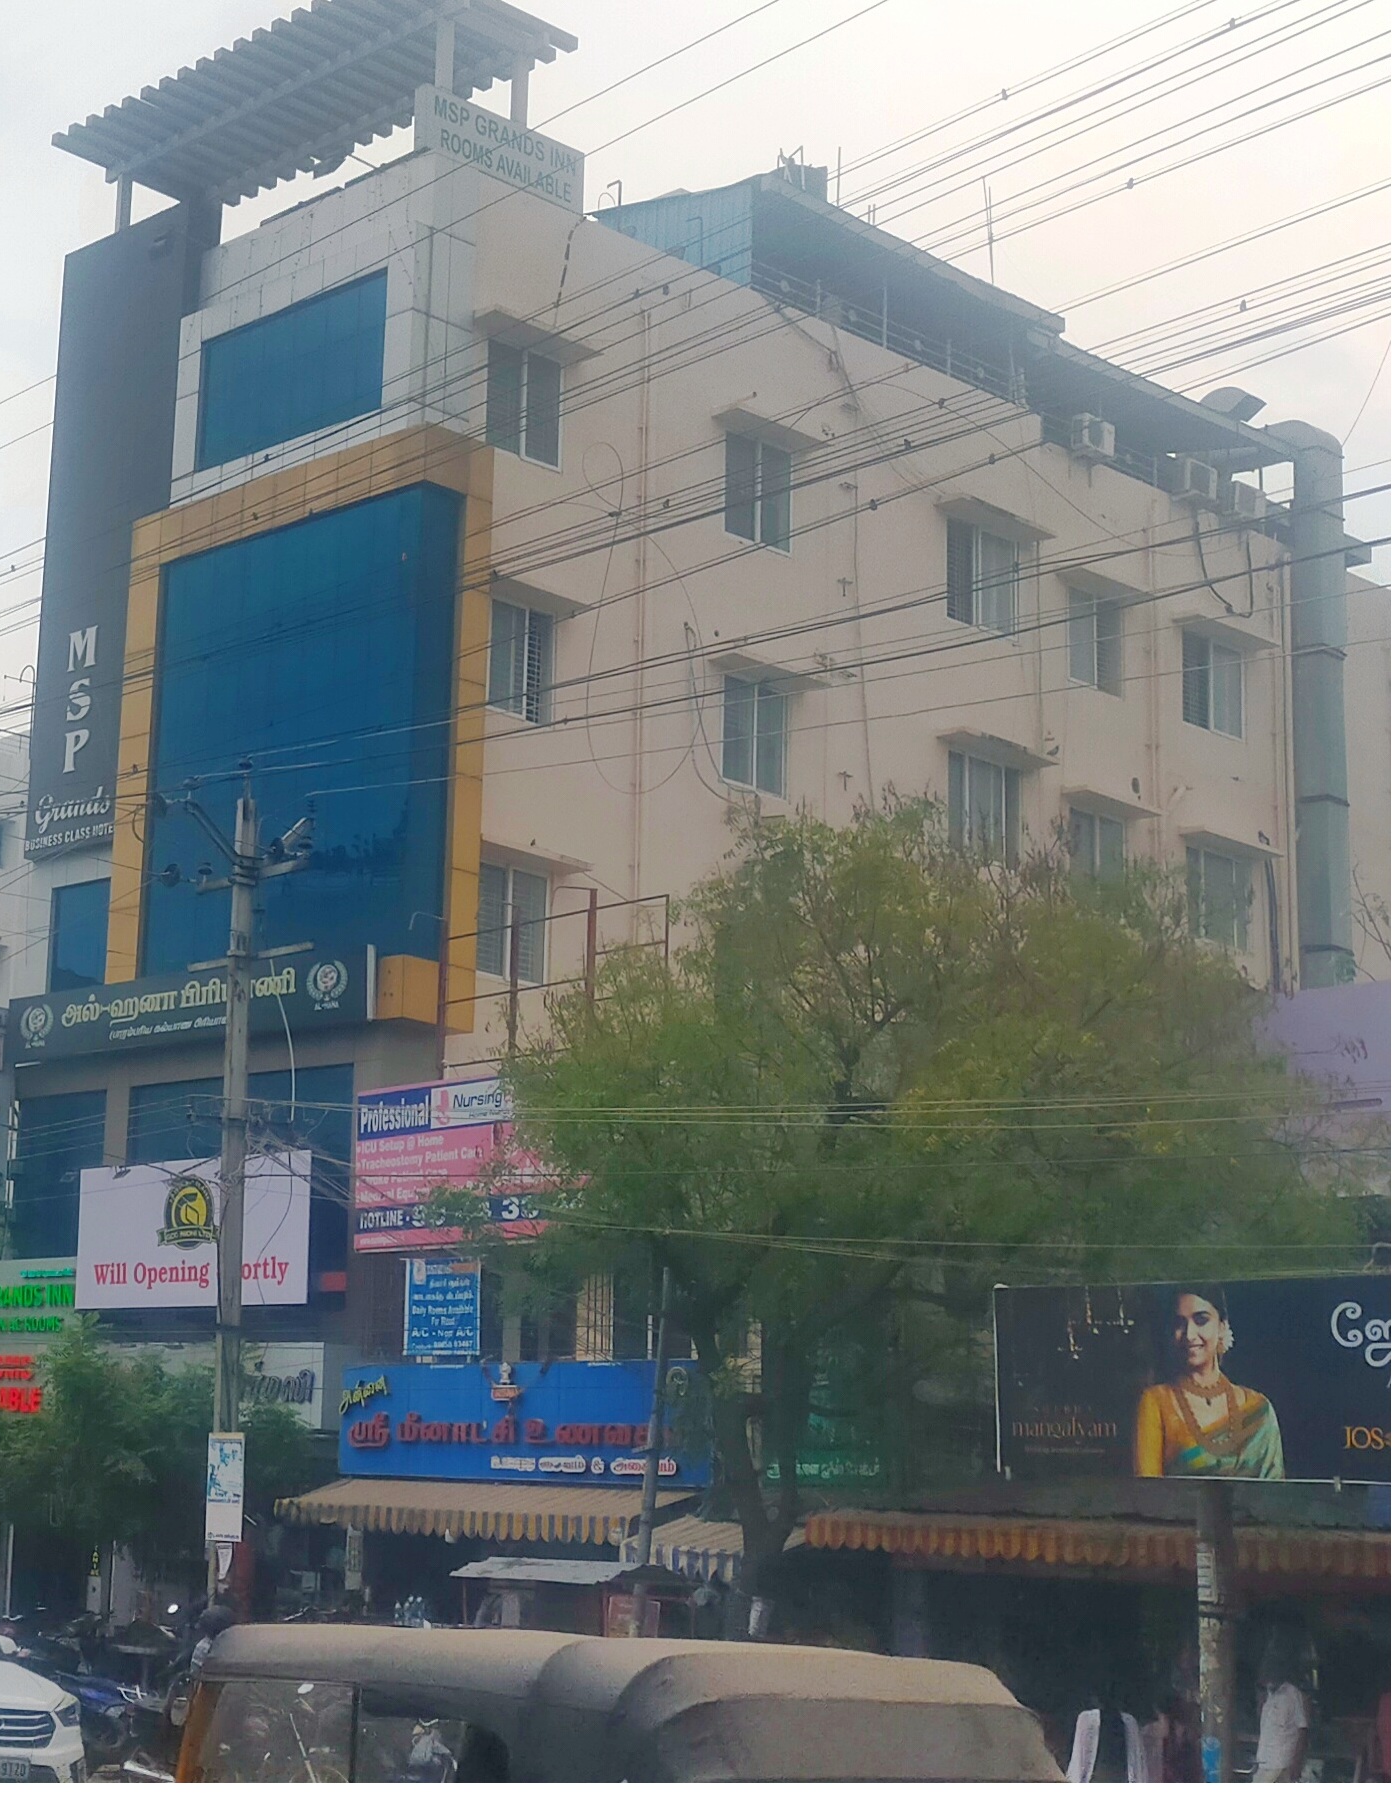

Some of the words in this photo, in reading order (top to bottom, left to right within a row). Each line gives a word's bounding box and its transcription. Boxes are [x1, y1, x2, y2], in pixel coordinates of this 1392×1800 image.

[434, 94, 470, 126] MSP
[475, 115, 545, 161] GRANDS
[550, 149, 576, 176] INN
[440, 128, 493, 169] ROOMS
[496, 154, 572, 203] AVAILABLE
[62, 624, 99, 775] MSP
[34, 785, 111, 834] Grands
[24, 832, 63, 852] BUSINESS
[64, 826, 91, 844] CLASS
[92, 822, 116, 837] HOTE
[360, 1094, 430, 1134] Professional
[453, 1090, 503, 1109] Nursing
[361, 1141, 377, 1154] ICU
[379, 1140, 405, 1153] Setup
[417, 1134, 445, 1147] Home
[425, 1148, 459, 1163] Patient
[360, 1209, 404, 1230] HOTLINE
[94, 1262, 127, 1286] Will
[133, 1259, 210, 1289] Opening
[217, 1255, 290, 1286] ortly
[46, 1283, 74, 1306] INN
